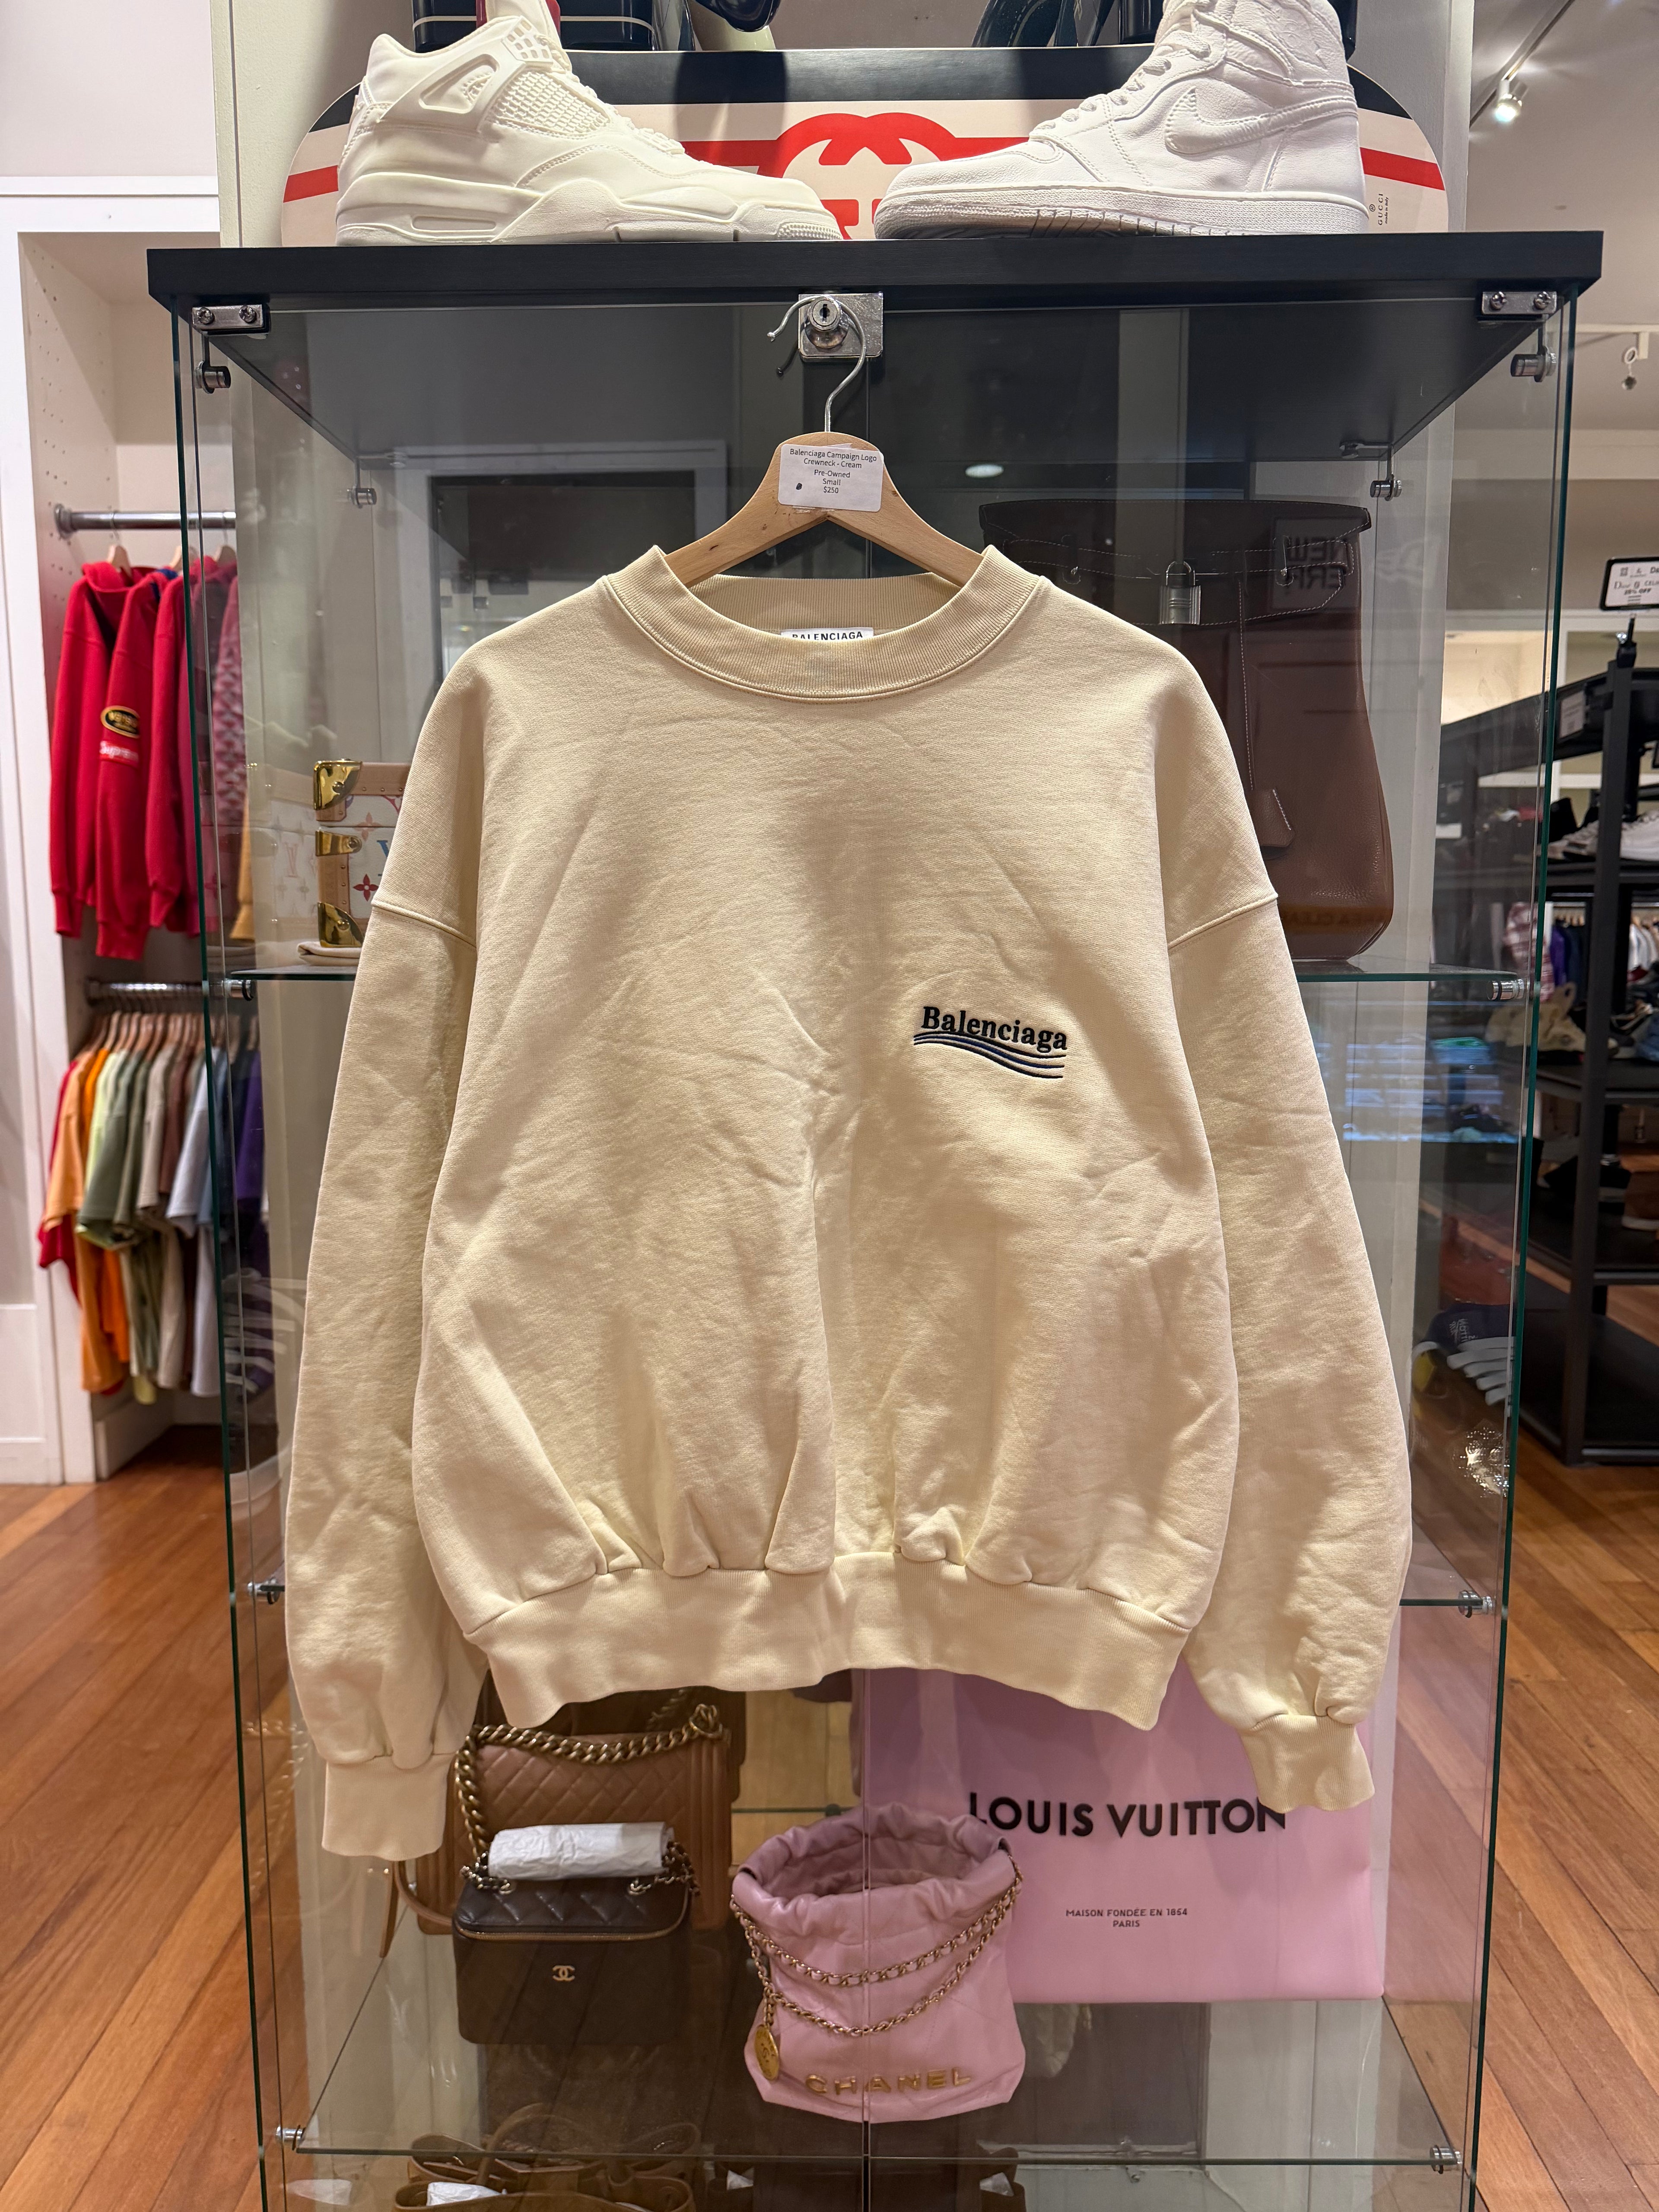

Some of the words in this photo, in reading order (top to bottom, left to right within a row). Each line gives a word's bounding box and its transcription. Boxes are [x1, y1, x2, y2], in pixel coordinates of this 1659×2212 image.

[790, 448, 825, 457] Balenciaga
[827, 451, 859, 461] Campaign
[861, 454, 877, 463] Logo
[804, 458, 836, 467] Crewneck
[814, 469, 850, 478] Pre-Owned
[921, 1006, 1068, 1053] Balenciaga
[970, 1792, 1093, 1837] LOUIS
[1106, 1797, 1286, 1838] VUITTON
[1106, 1907, 1147, 1916] FONDÉE
[805, 2067, 971, 2095] CHANEL
